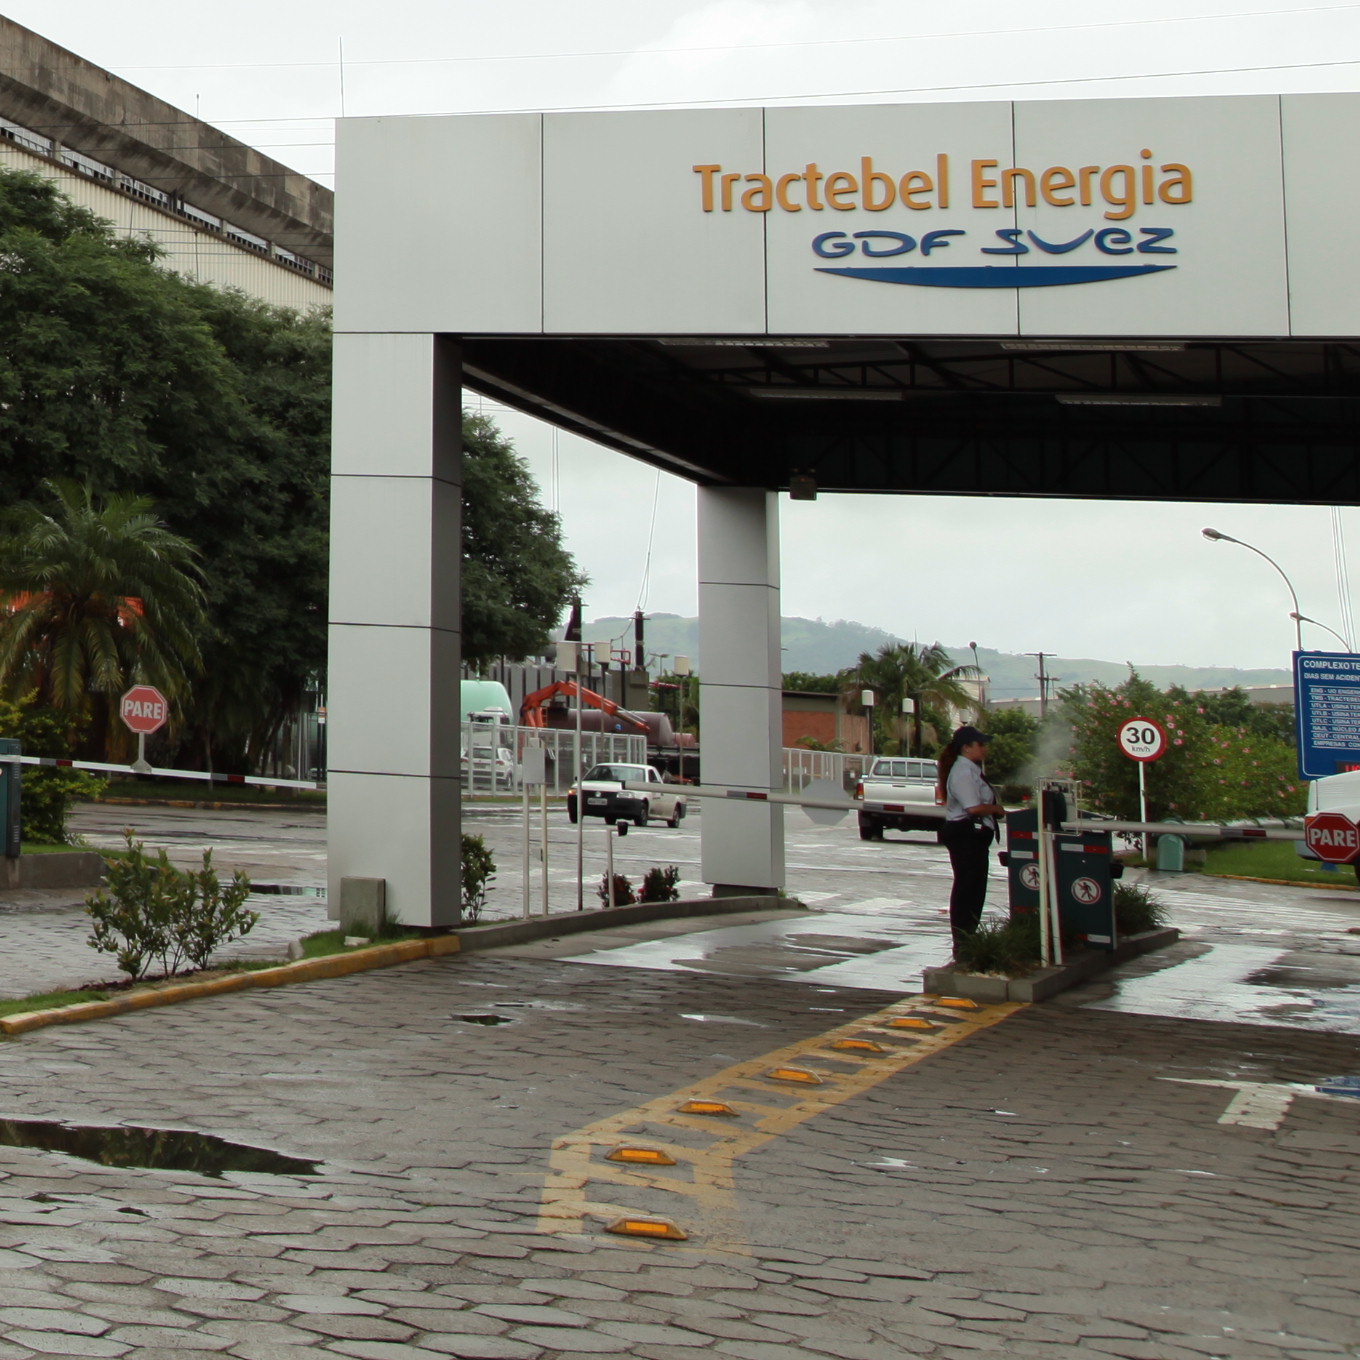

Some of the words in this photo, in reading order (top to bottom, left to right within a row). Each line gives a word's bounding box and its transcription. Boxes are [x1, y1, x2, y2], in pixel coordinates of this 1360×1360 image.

[692, 153, 949, 213] Tractebel
[970, 148, 1193, 220] Energia
[811, 228, 966, 258] GDF
[1303, 660, 1350, 670] COMPLEXO
[1303, 672, 1319, 680] DIAS
[124, 699, 162, 720] PARE
[1126, 727, 1155, 745] 30
[1310, 828, 1357, 848] PARE
